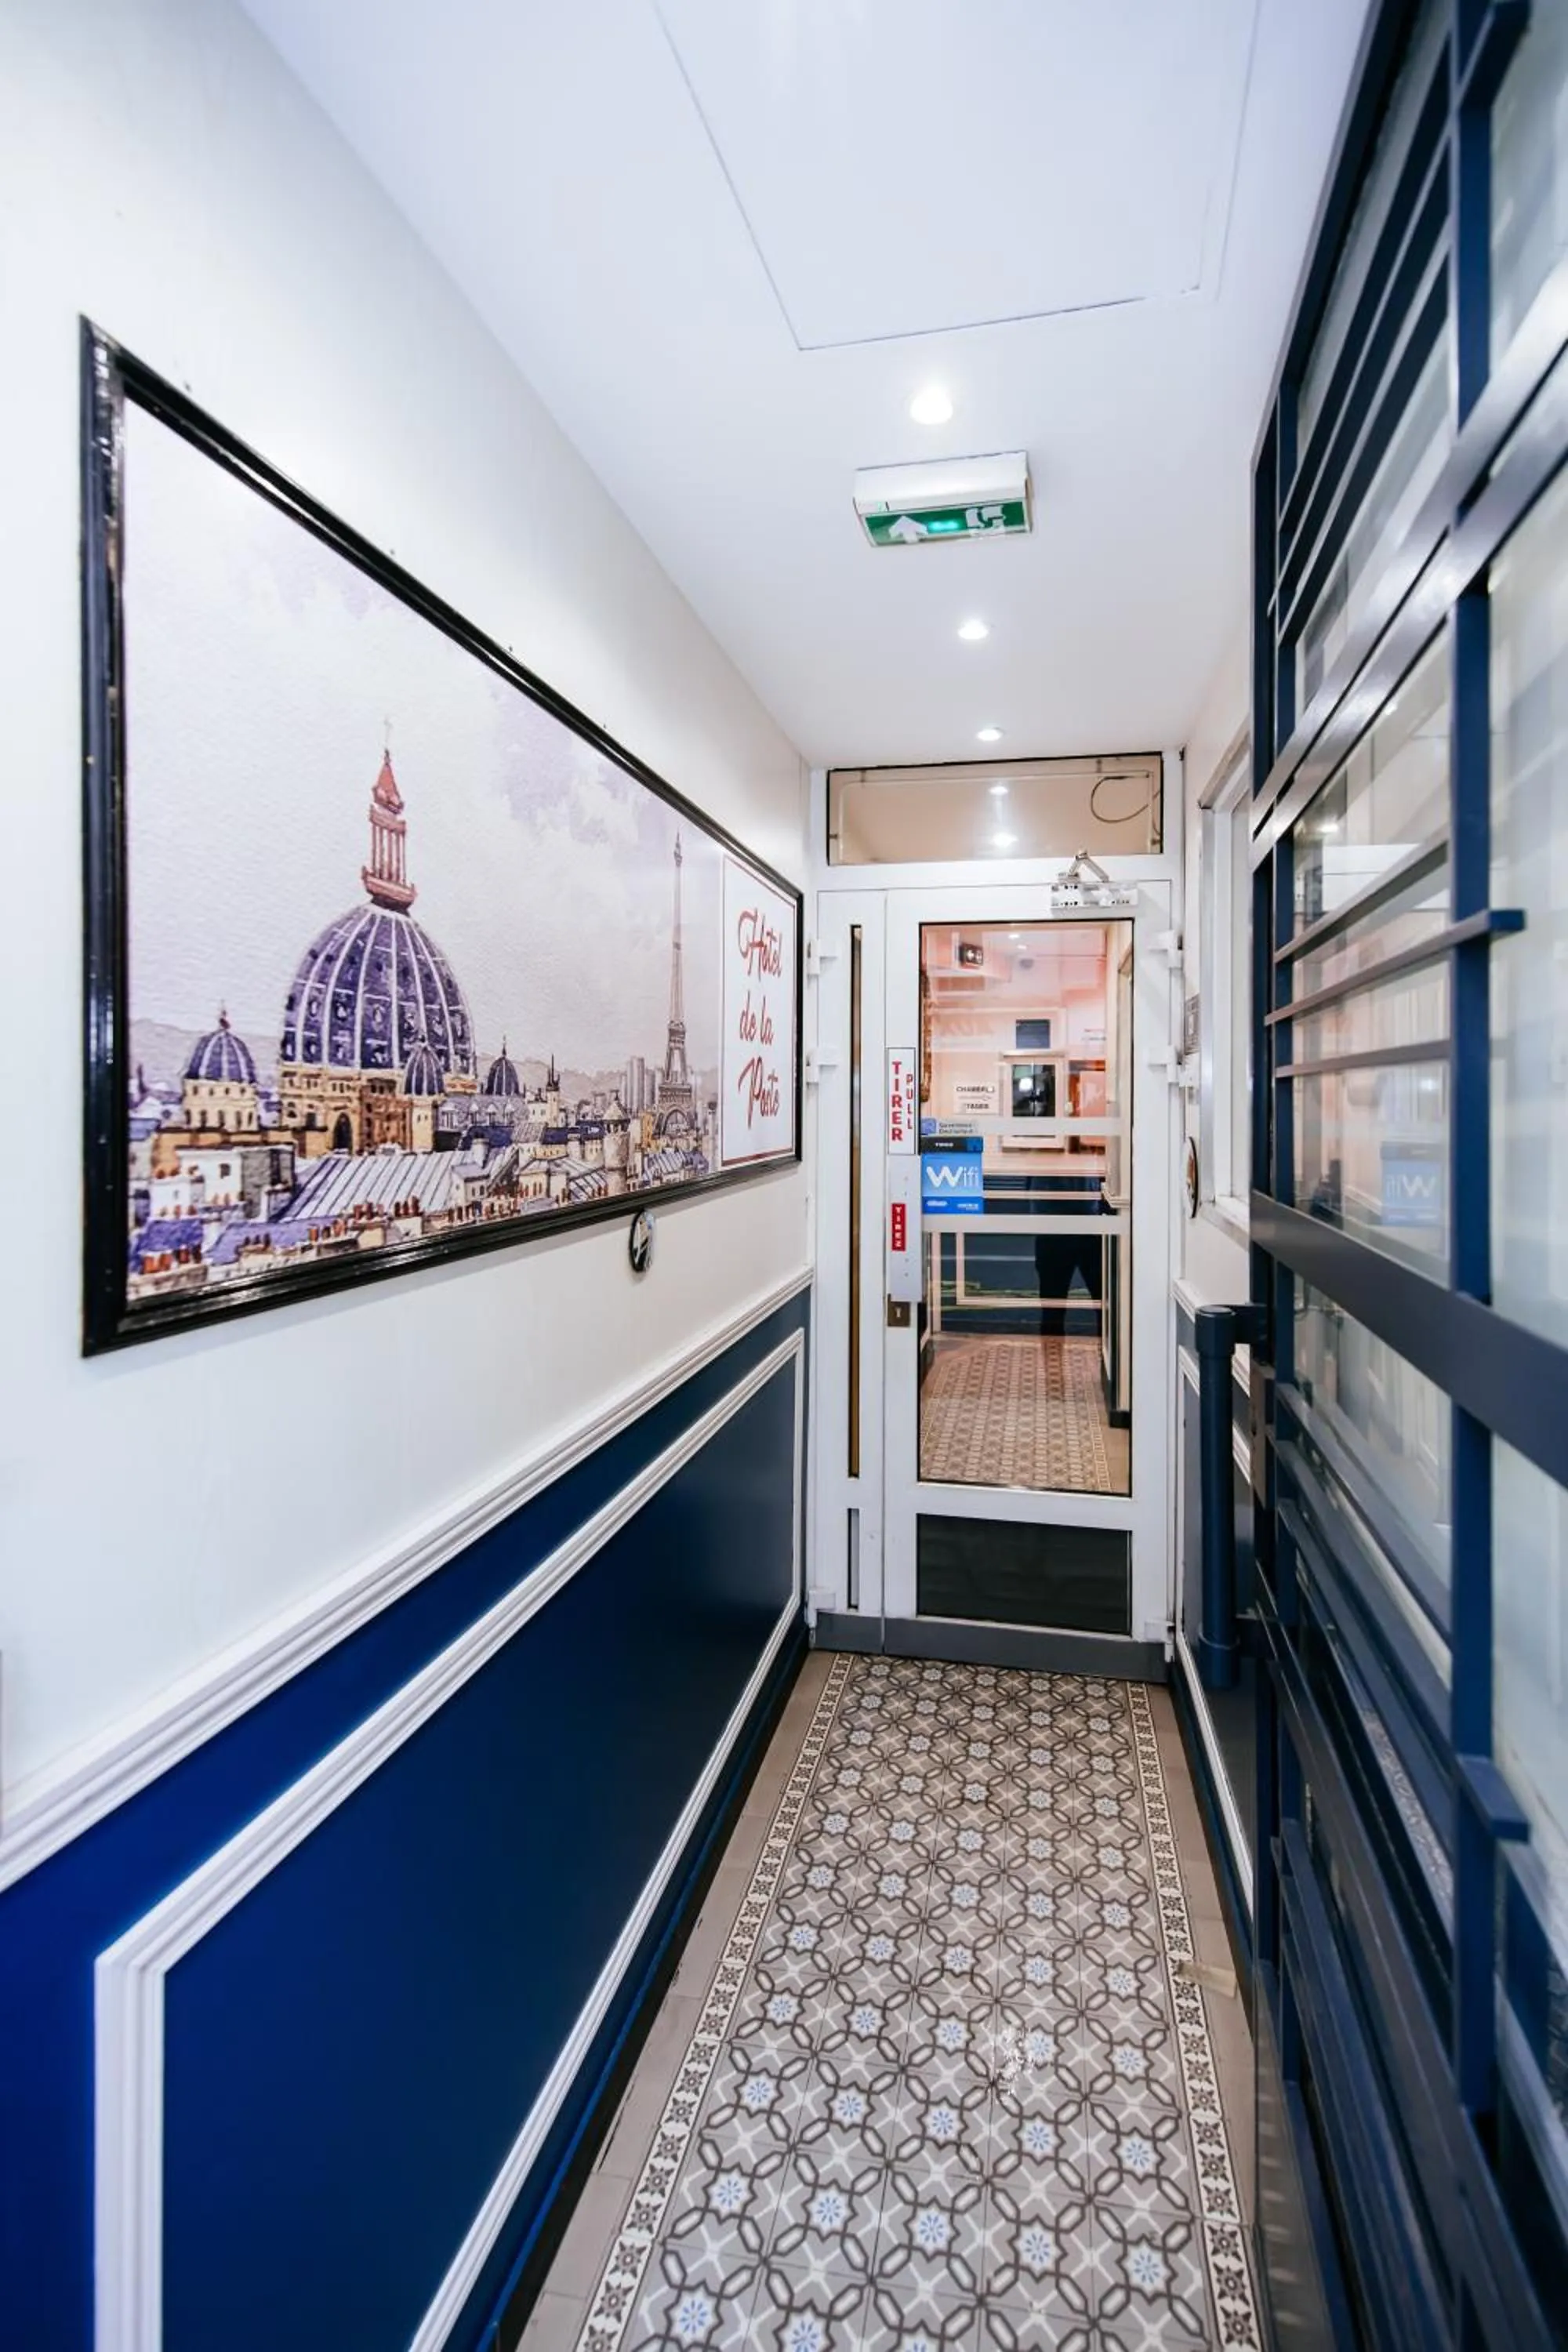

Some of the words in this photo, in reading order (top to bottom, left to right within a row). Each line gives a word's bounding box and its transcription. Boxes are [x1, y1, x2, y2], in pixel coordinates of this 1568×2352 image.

[739, 989, 757, 1042] de
[760, 995, 775, 1046] la
[738, 1054, 780, 1130] Poste
[891, 1061, 902, 1142] TIRER
[926, 1166, 979, 1187] Wifi
